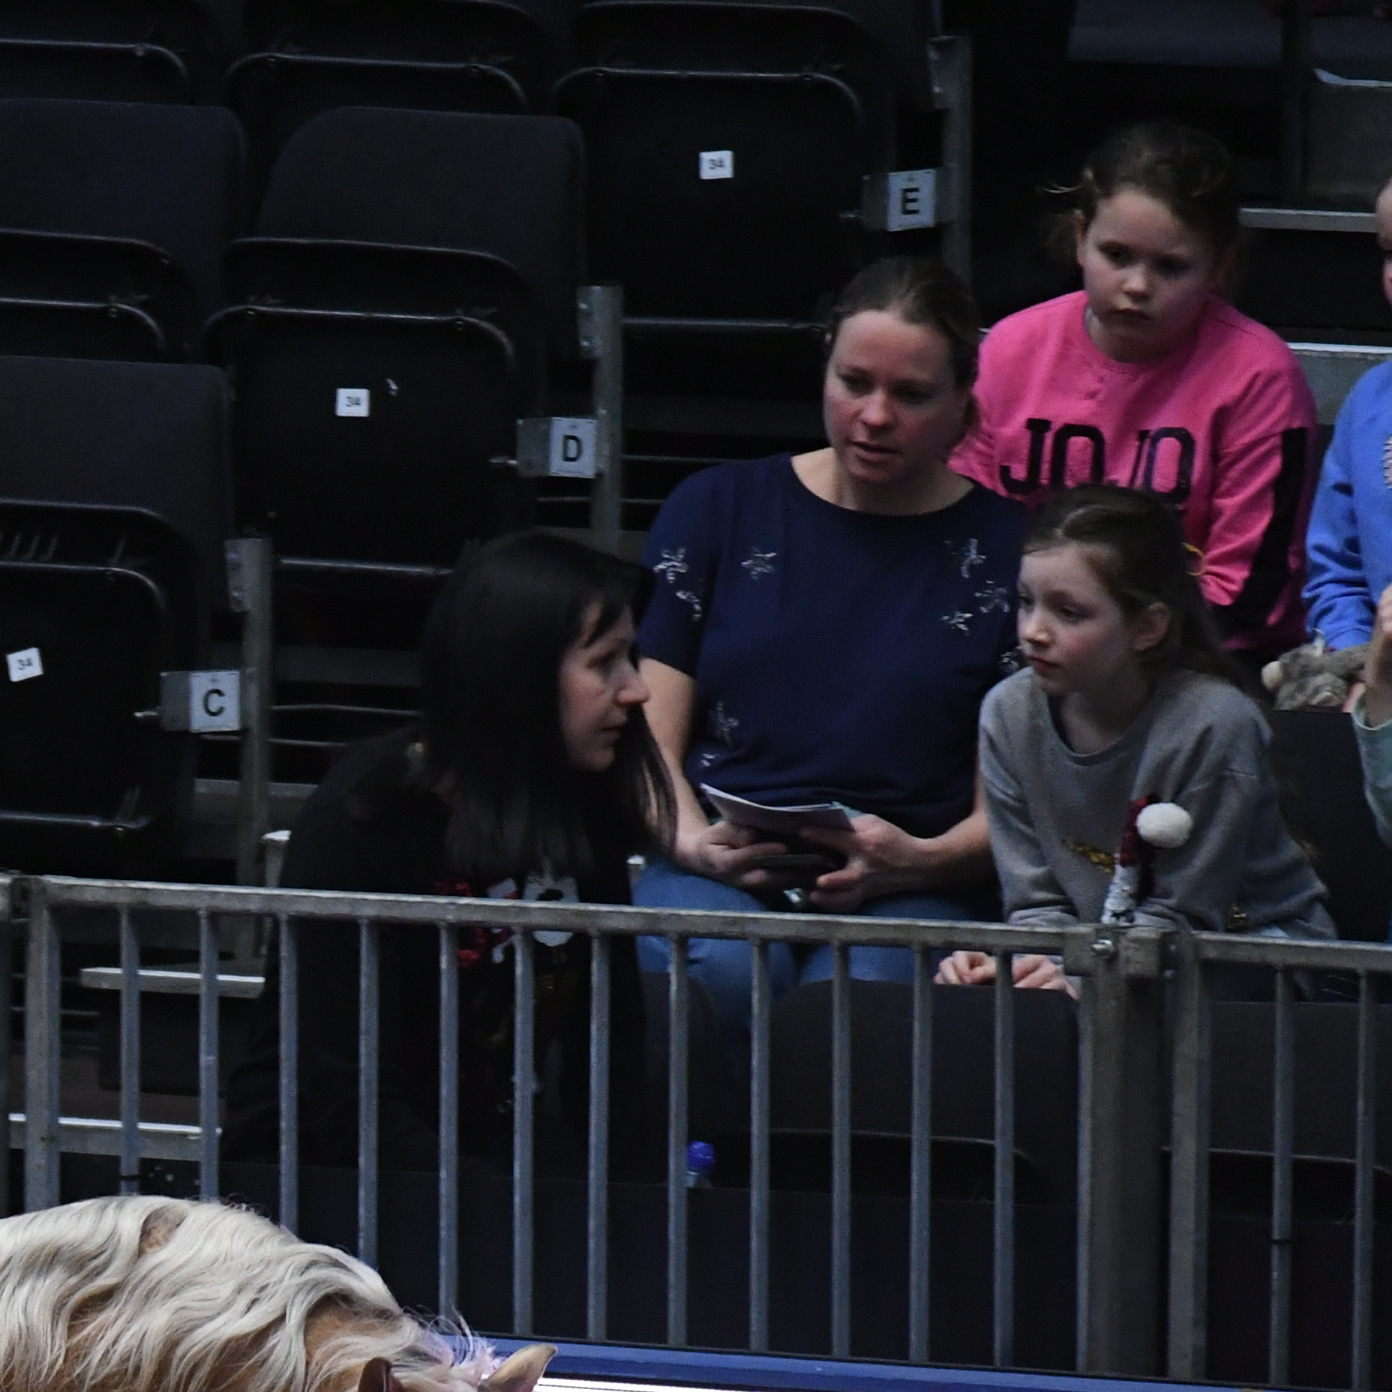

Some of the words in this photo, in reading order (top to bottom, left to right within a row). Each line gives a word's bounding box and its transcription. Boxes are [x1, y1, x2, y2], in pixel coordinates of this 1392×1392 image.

[902, 188, 920, 215] E
[562, 434, 582, 462] D
[1000, 418, 1196, 500] JOJO
[203, 688, 225, 717] C
